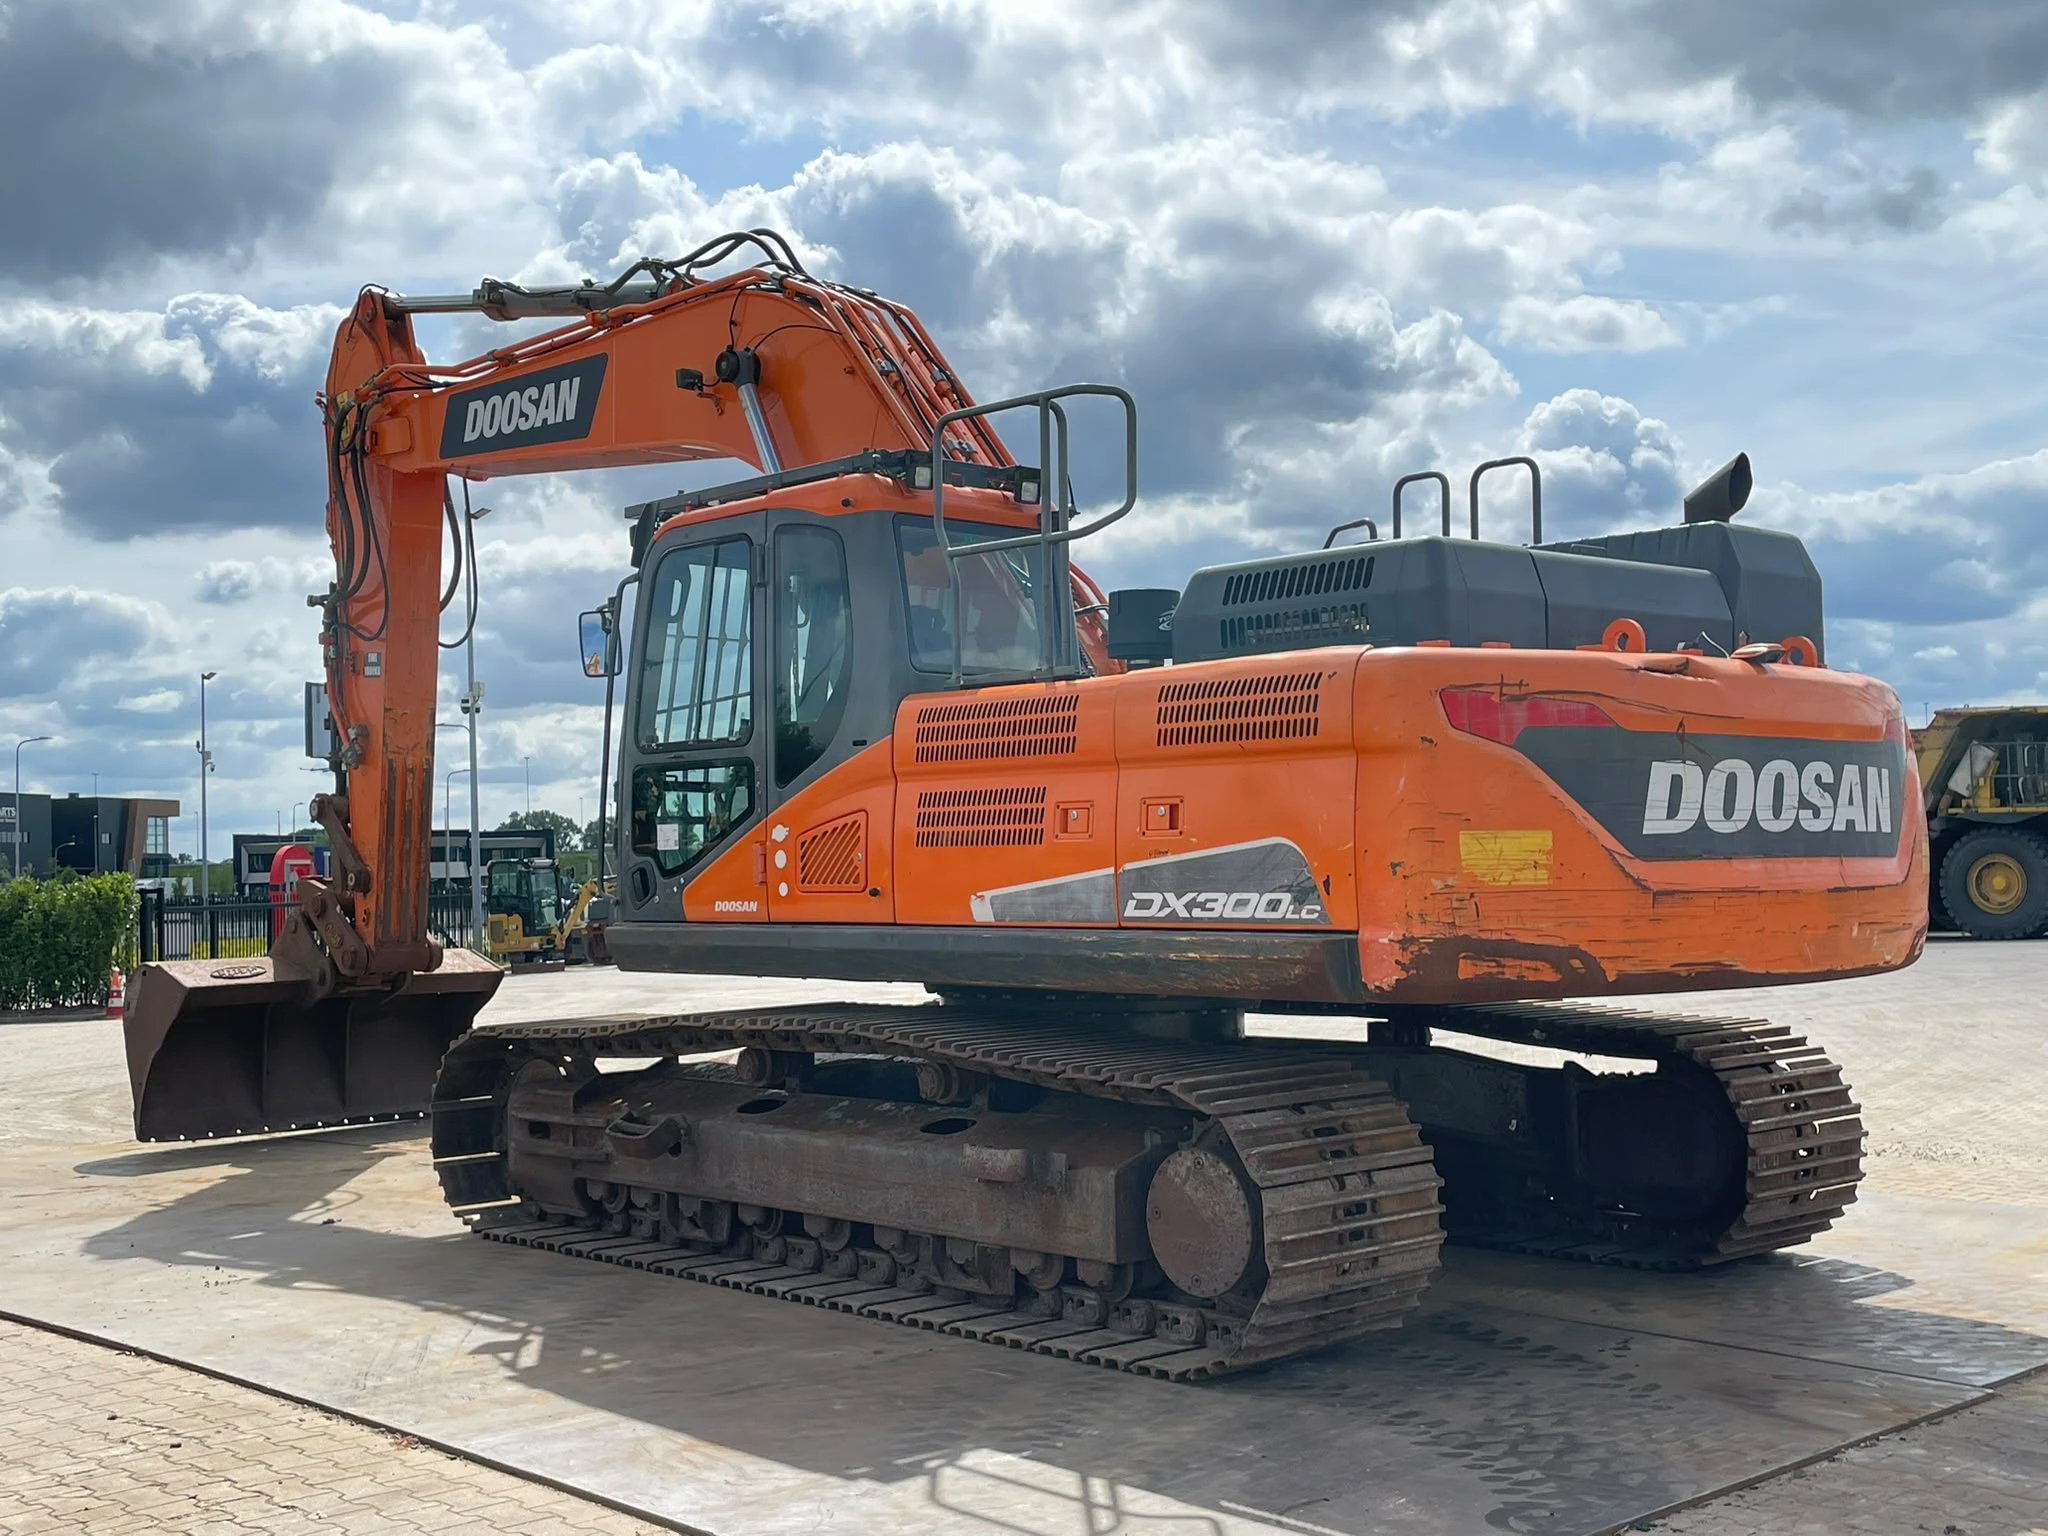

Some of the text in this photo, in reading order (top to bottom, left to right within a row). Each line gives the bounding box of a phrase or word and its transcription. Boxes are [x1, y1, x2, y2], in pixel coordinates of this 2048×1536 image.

[464, 377, 580, 442] DOOSAN
[1642, 758, 1891, 835] DOOSAN
[715, 900, 757, 912] DOOSAN
